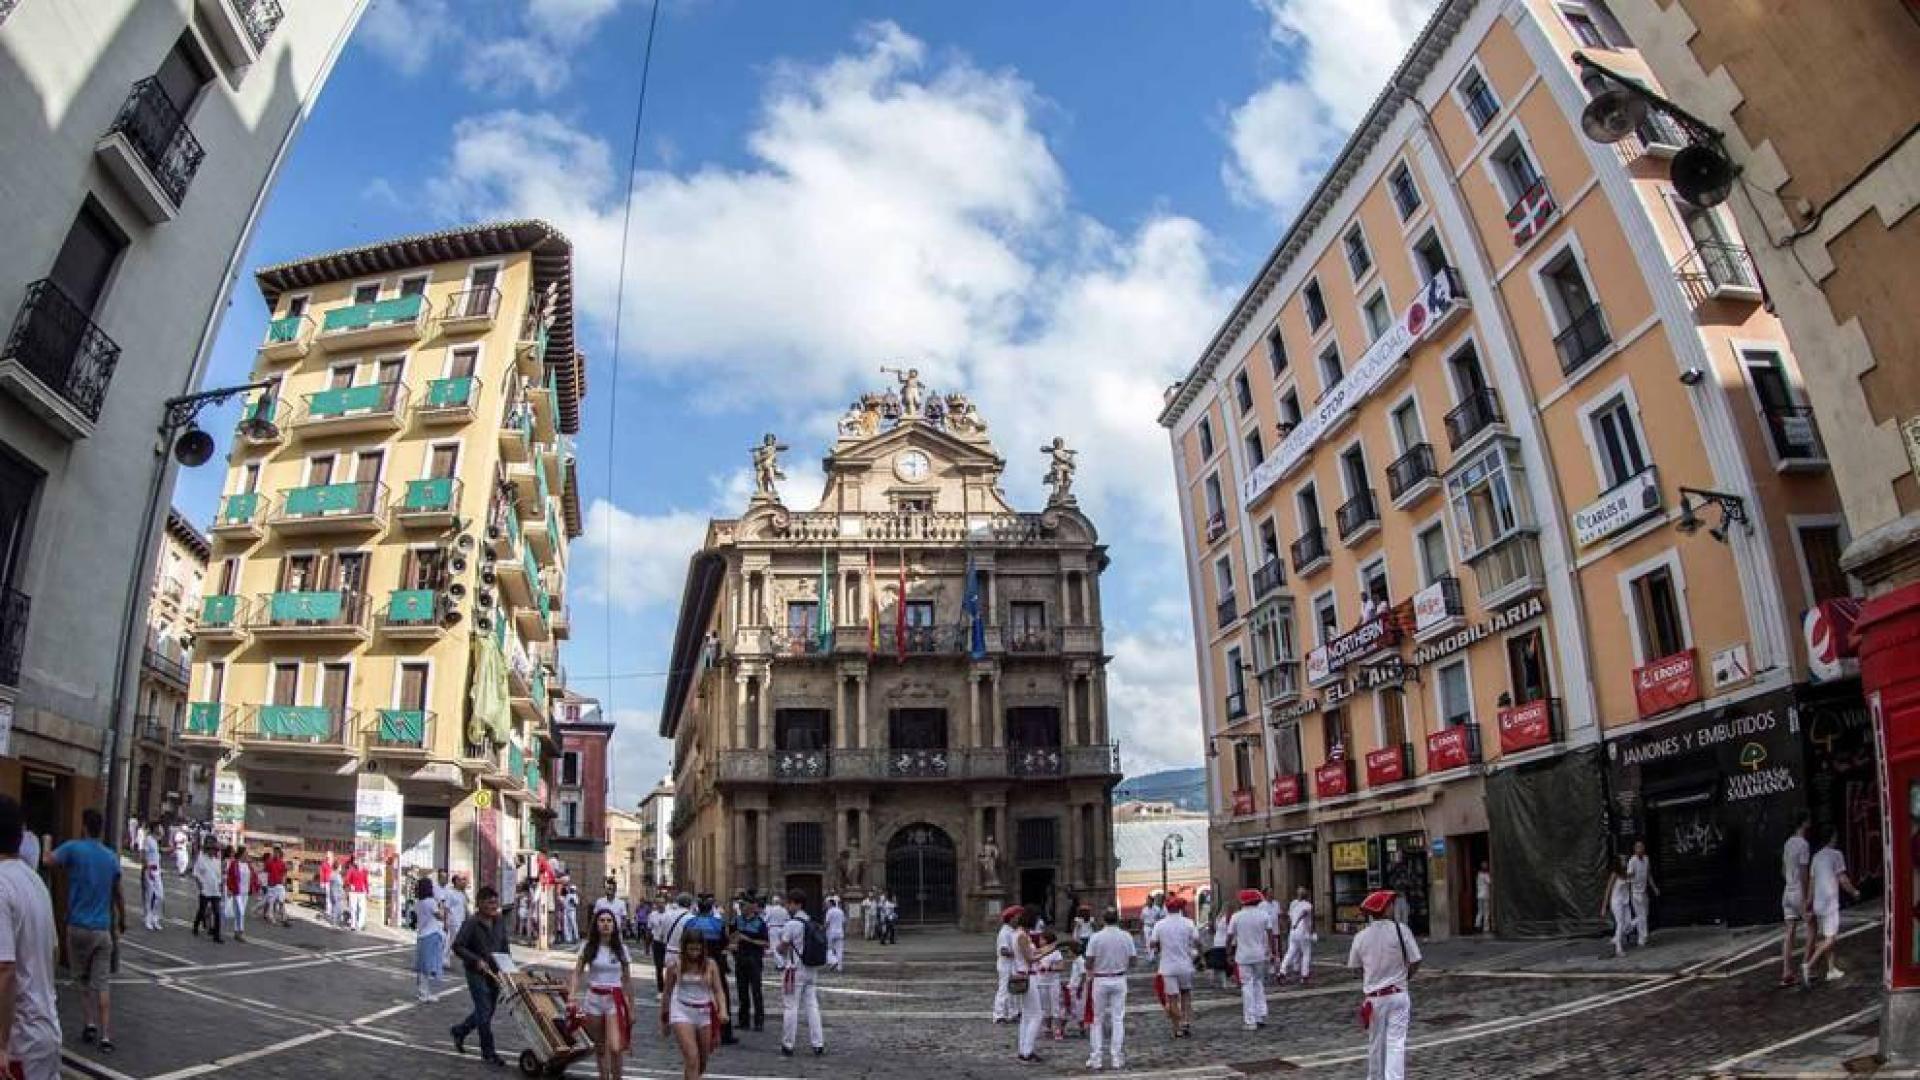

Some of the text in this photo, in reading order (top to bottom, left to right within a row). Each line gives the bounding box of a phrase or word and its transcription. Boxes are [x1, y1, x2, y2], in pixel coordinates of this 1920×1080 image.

[1320, 390, 1345, 425] STOP
[1586, 501, 1618, 528] CARLOS
[1327, 618, 1384, 659] NORTHERN
[1415, 596, 1543, 666] INMOBILIARIA
[1623, 736, 1680, 766] JAMONES
[1683, 733, 1692, 750] Y
[1698, 710, 1776, 746] EMBUTIDOS
[1727, 775, 1795, 802] SALAMANCA
[1728, 770, 1777, 793] VIANDAS
